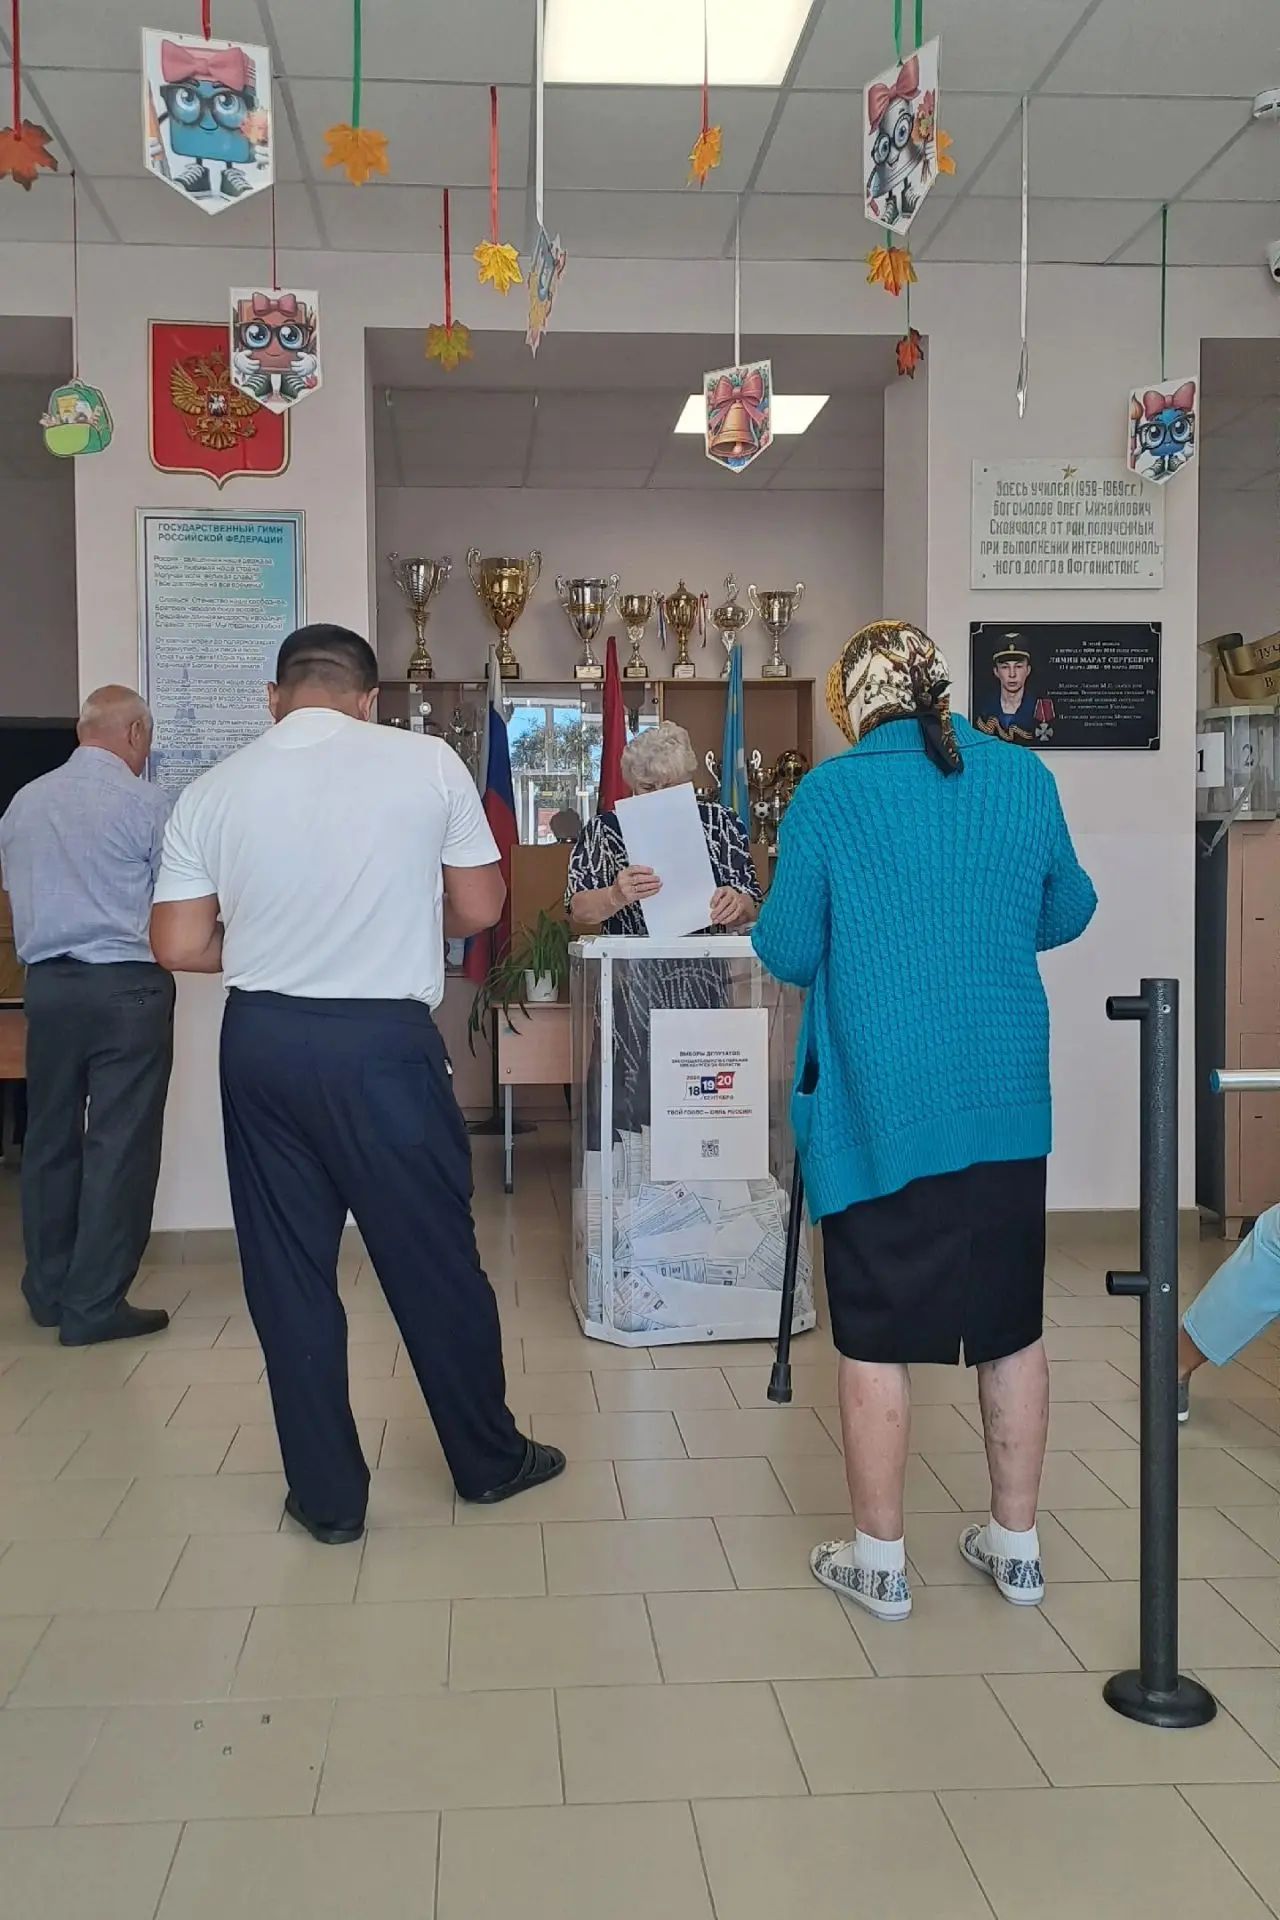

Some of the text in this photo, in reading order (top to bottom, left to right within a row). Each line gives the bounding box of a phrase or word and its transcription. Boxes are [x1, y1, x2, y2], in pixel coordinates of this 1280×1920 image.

[158, 523, 283, 534] ГОСУДАРСТВЕННЫЙ ГИМН
[158, 533, 283, 544] РОССИЙСКОЙ ФЕДЕРАЦИИ
[1079, 656, 1106, 664] МАРАТ
[688, 1075, 732, 1096] 18 19 20
